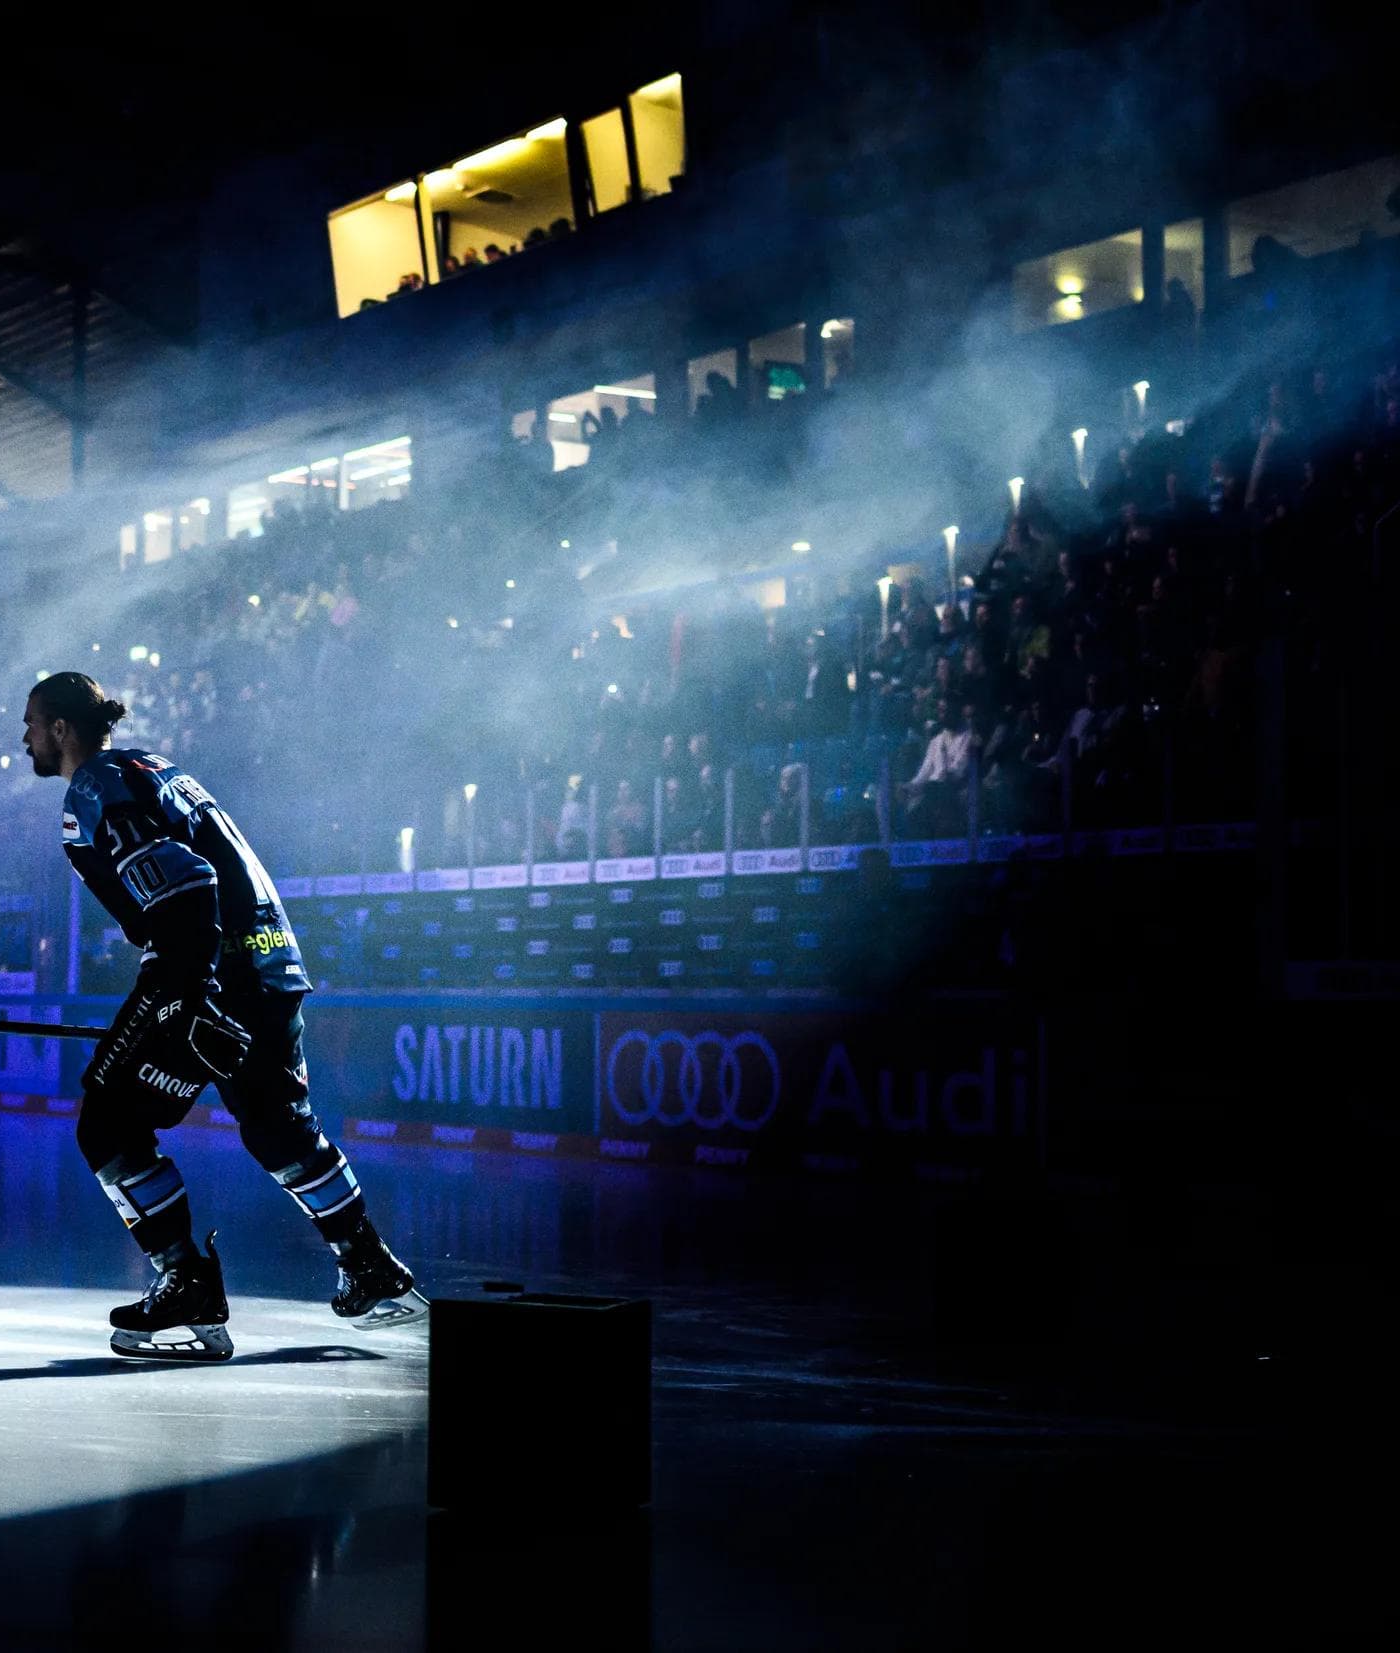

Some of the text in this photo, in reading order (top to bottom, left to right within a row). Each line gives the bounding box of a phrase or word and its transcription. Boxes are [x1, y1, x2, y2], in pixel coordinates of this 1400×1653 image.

[139, 1063, 200, 1098] CINQUE
[393, 1024, 562, 1109] SATURN
[807, 1041, 1028, 1136] Audi
